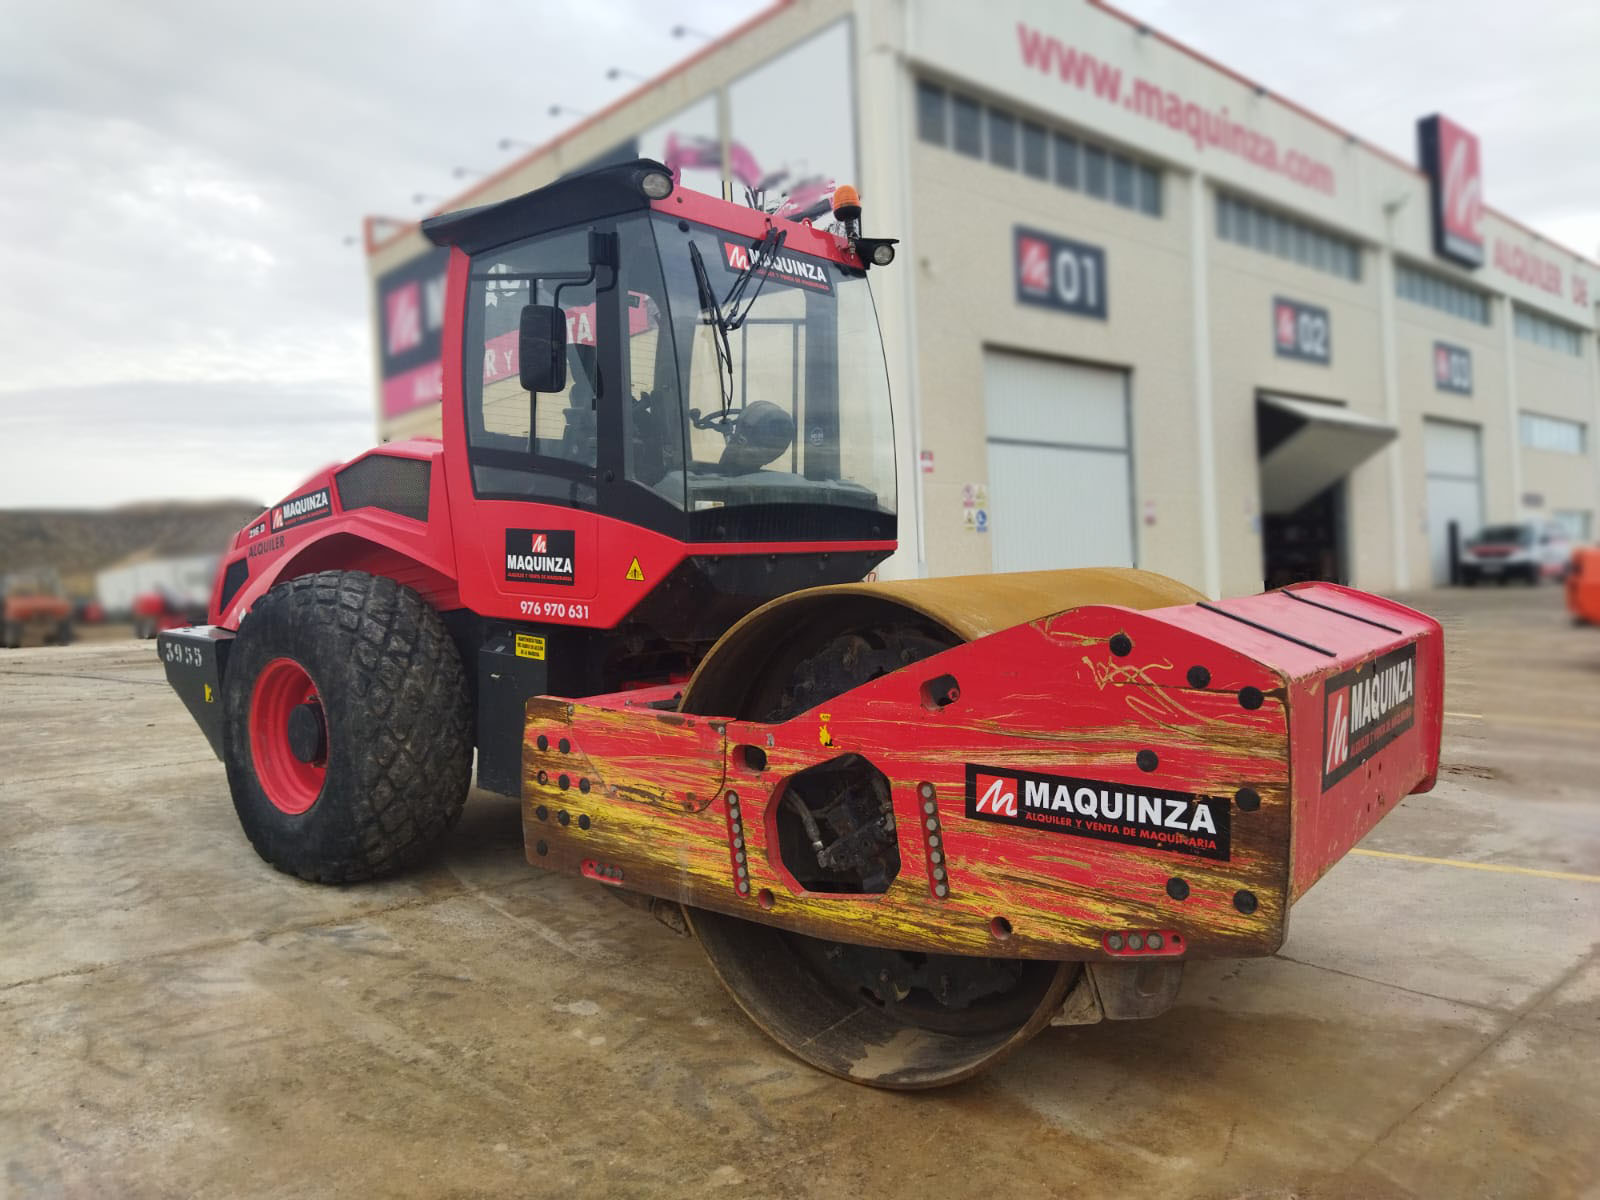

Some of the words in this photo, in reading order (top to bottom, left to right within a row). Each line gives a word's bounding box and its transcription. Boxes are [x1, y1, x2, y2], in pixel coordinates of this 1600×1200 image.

[1016, 20, 1336, 197] www.maquinza.com
[1056, 250, 1097, 306] 01
[283, 491, 328, 519] MAQUINZA
[507, 554, 573, 573] MAQUINZA
[520, 601, 541, 616] 976
[543, 602, 566, 618] 970
[568, 604, 590, 620] 631
[1350, 657, 1413, 734] MAQUINZA
[1025, 781, 1217, 834] MAQUINZA
[1025, 812, 1072, 827] ALQUILER
[1075, 818, 1083, 829] Y
[1085, 821, 1120, 834] VENTA
[1123, 826, 1137, 838] DE
